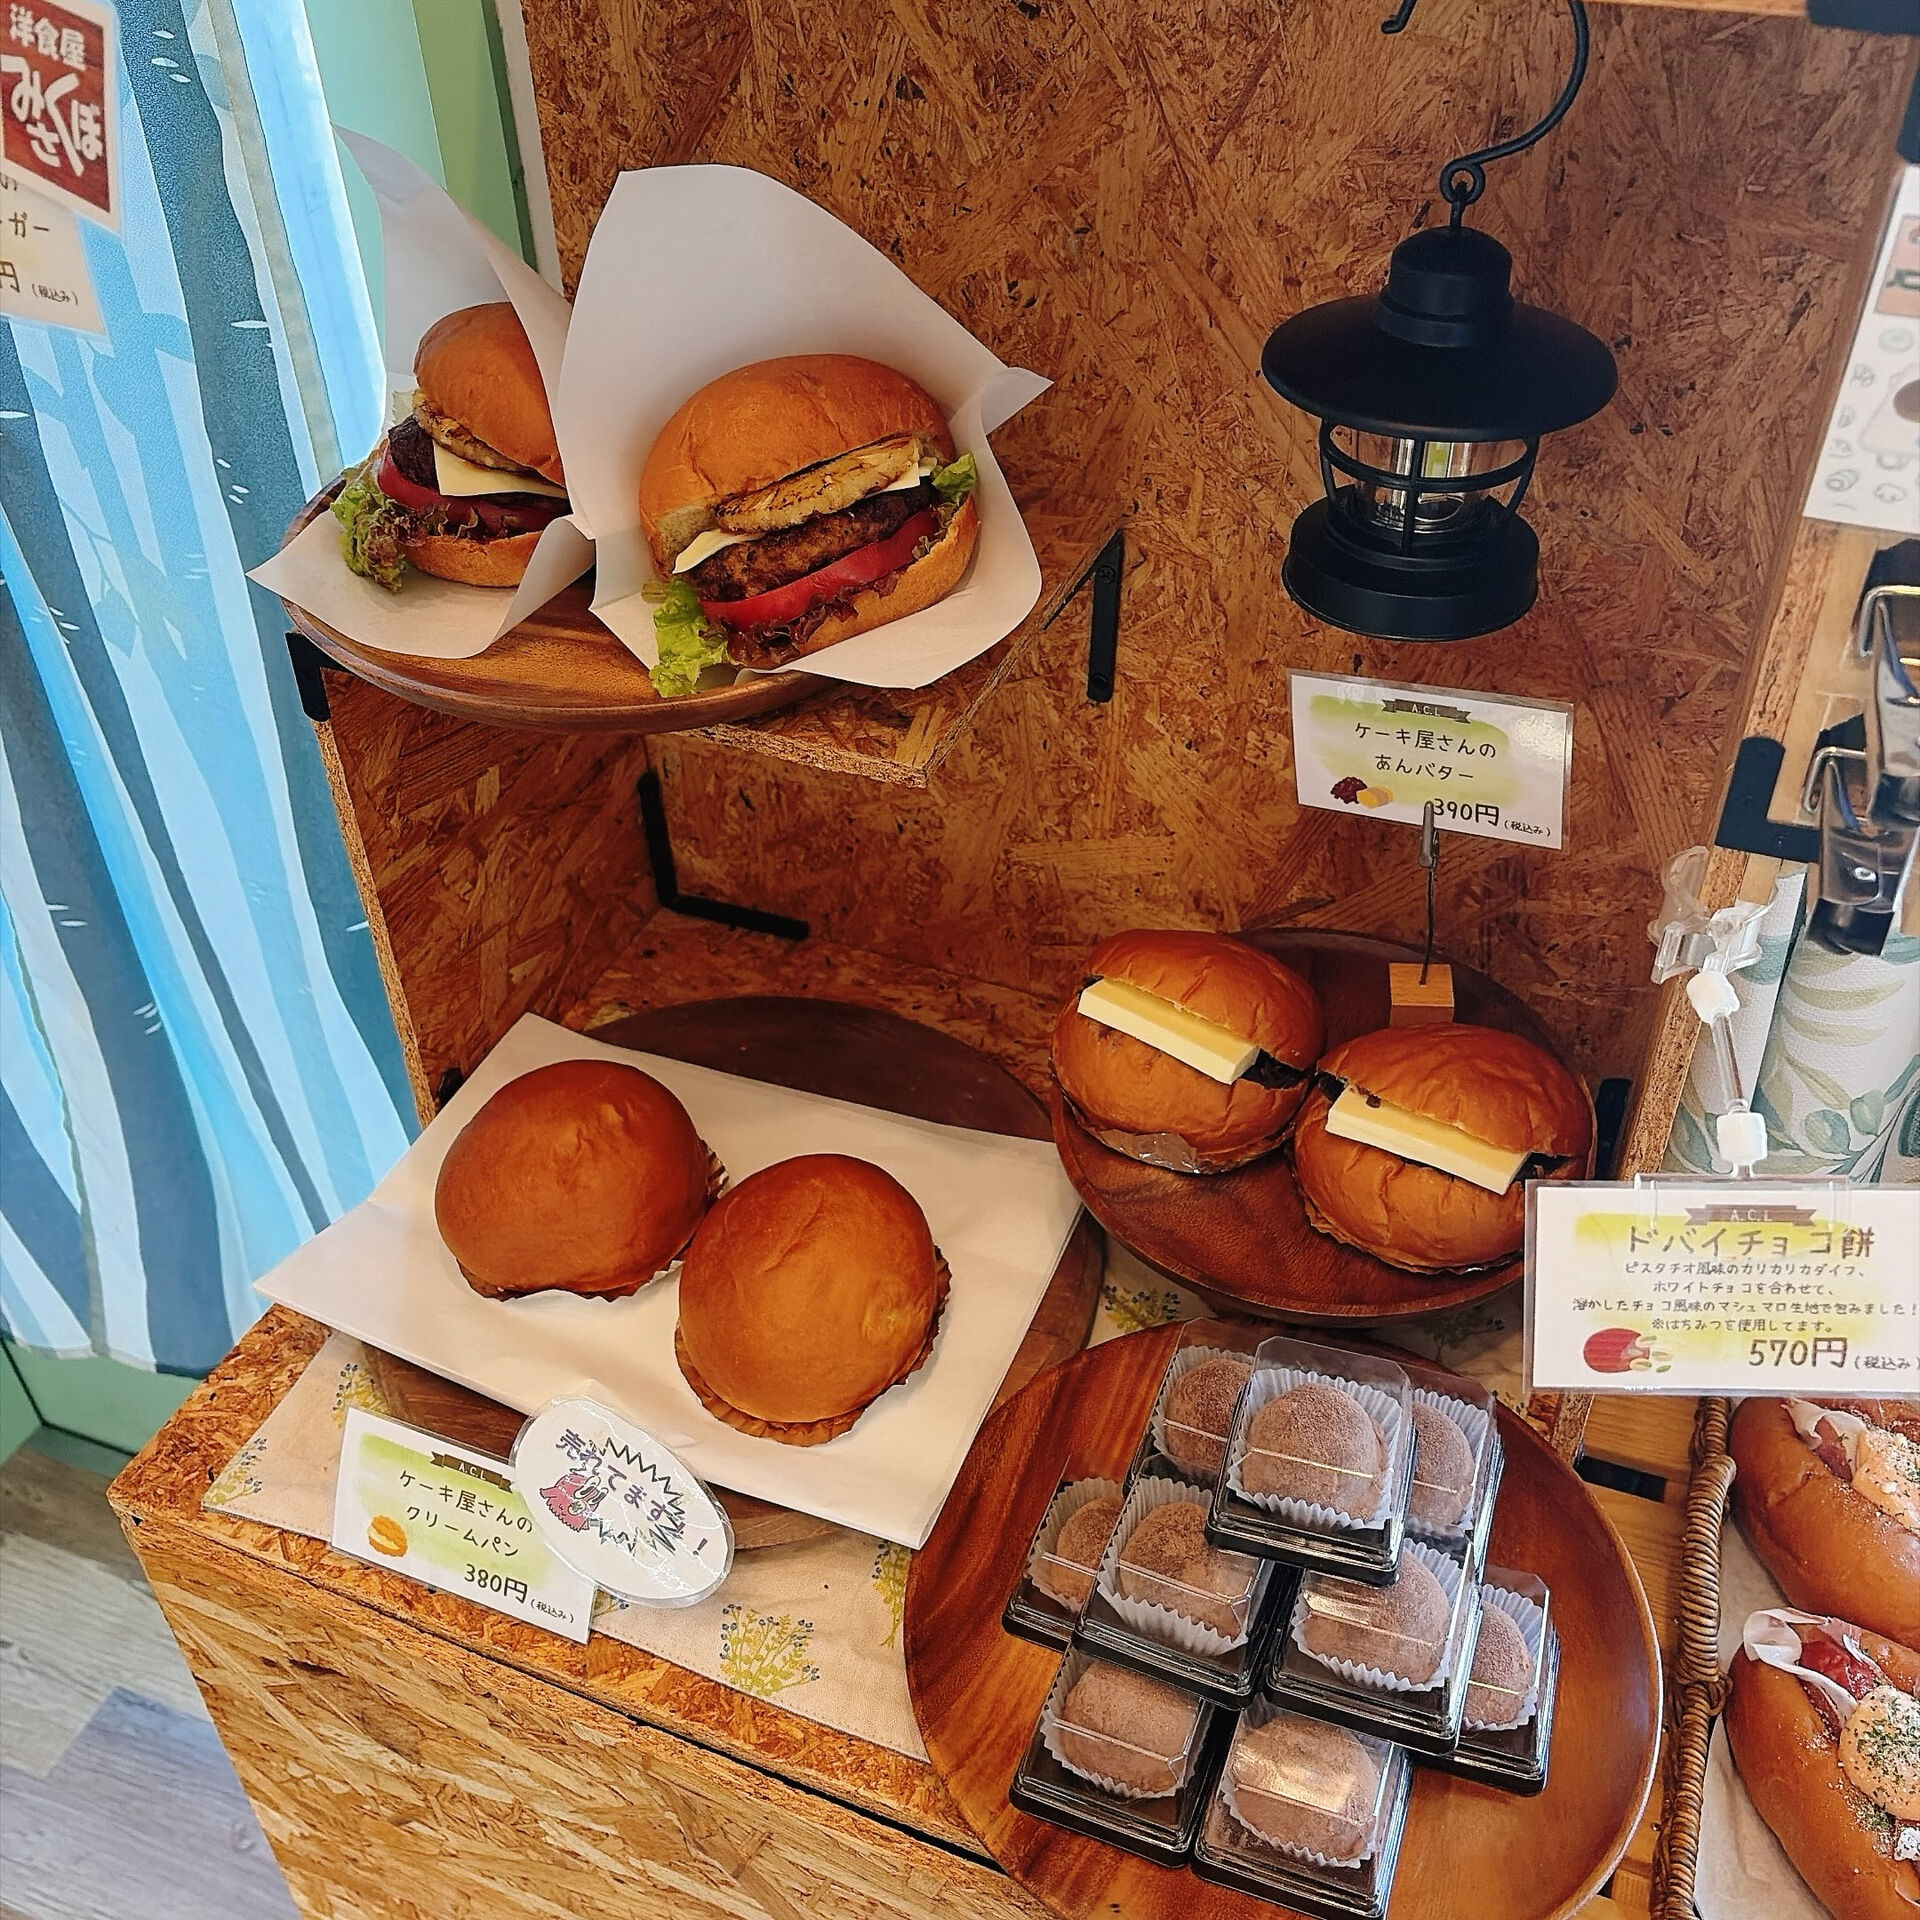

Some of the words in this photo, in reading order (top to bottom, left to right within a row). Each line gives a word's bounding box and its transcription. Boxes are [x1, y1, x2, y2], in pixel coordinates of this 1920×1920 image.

[10, 3, 86, 71] 洋食屋
[0, 211, 50, 238] ガー
[1355, 722, 1496, 758] ケーキ屋さんの
[1374, 754, 1474, 781] あんバター
[1433, 798, 1500, 827] 390円
[1504, 820, 1551, 837] (税込み)
[1628, 1225, 1875, 1259] ドバイチョコ餅
[1653, 1281, 1833, 1296] ホワイトチョコを合わせて、
[1749, 1337, 1848, 1368] 570円
[400, 1470, 533, 1533] ケーキ屋さんの
[407, 1506, 519, 1557] クリームパン
[464, 1563, 529, 1604] 380円
[530, 1598, 575, 1624] (税込み)
